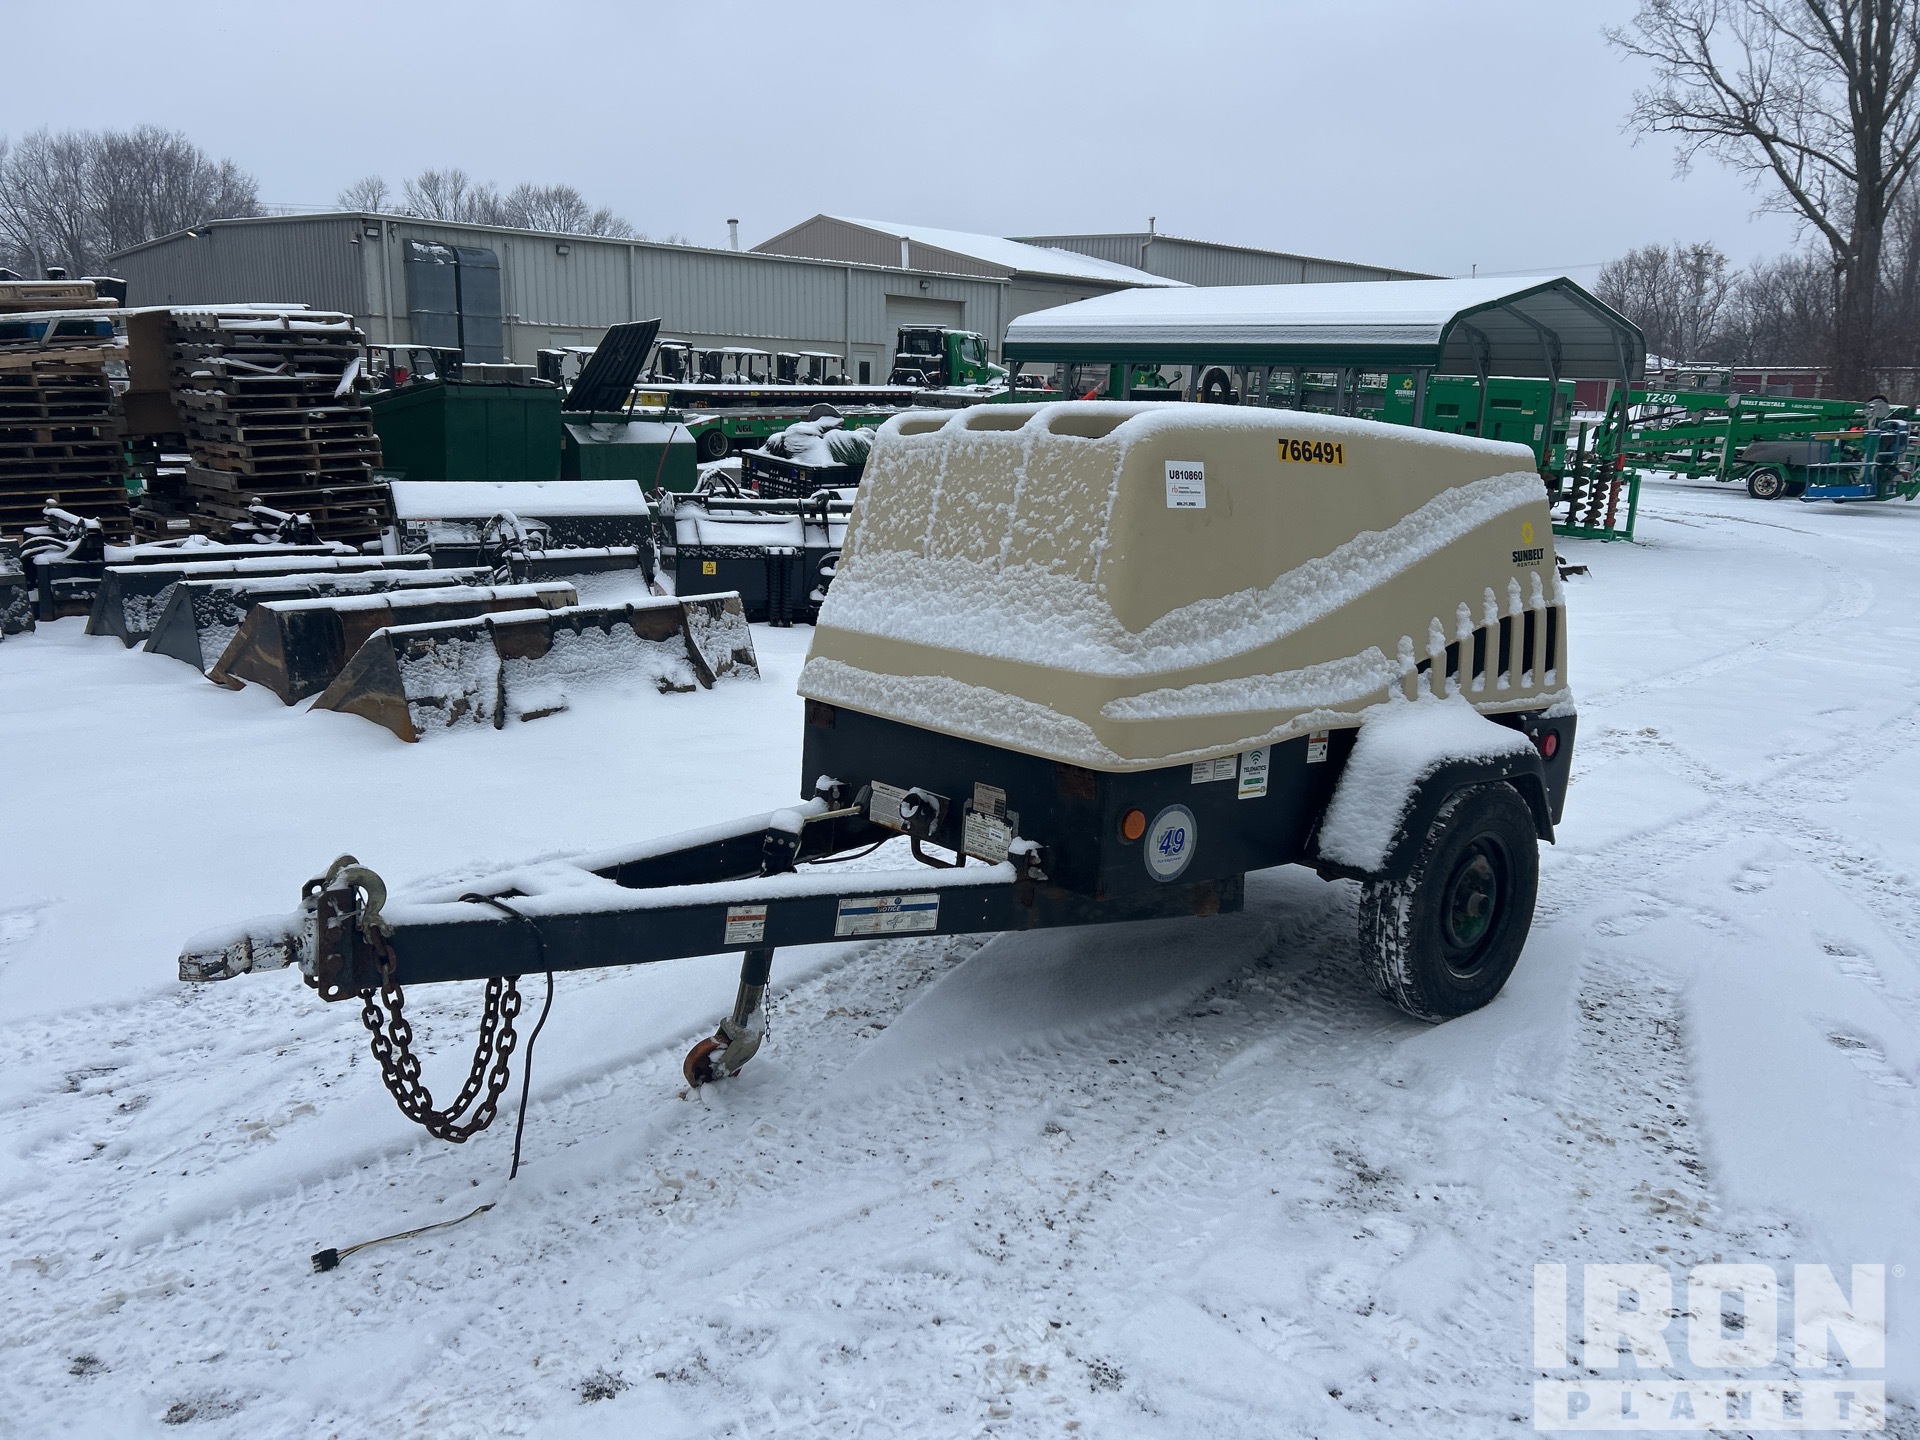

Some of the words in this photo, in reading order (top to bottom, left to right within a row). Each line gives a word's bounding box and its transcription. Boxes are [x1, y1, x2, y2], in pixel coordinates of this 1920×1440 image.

[1646, 393, 1677, 404] TZ-50
[1278, 439, 1343, 464] 766491
[1169, 470, 1203, 480] U810860
[1512, 548, 1544, 562] SUNBELT
[1244, 765, 1267, 773] TELEMATICS
[1158, 828, 1186, 855] 49
